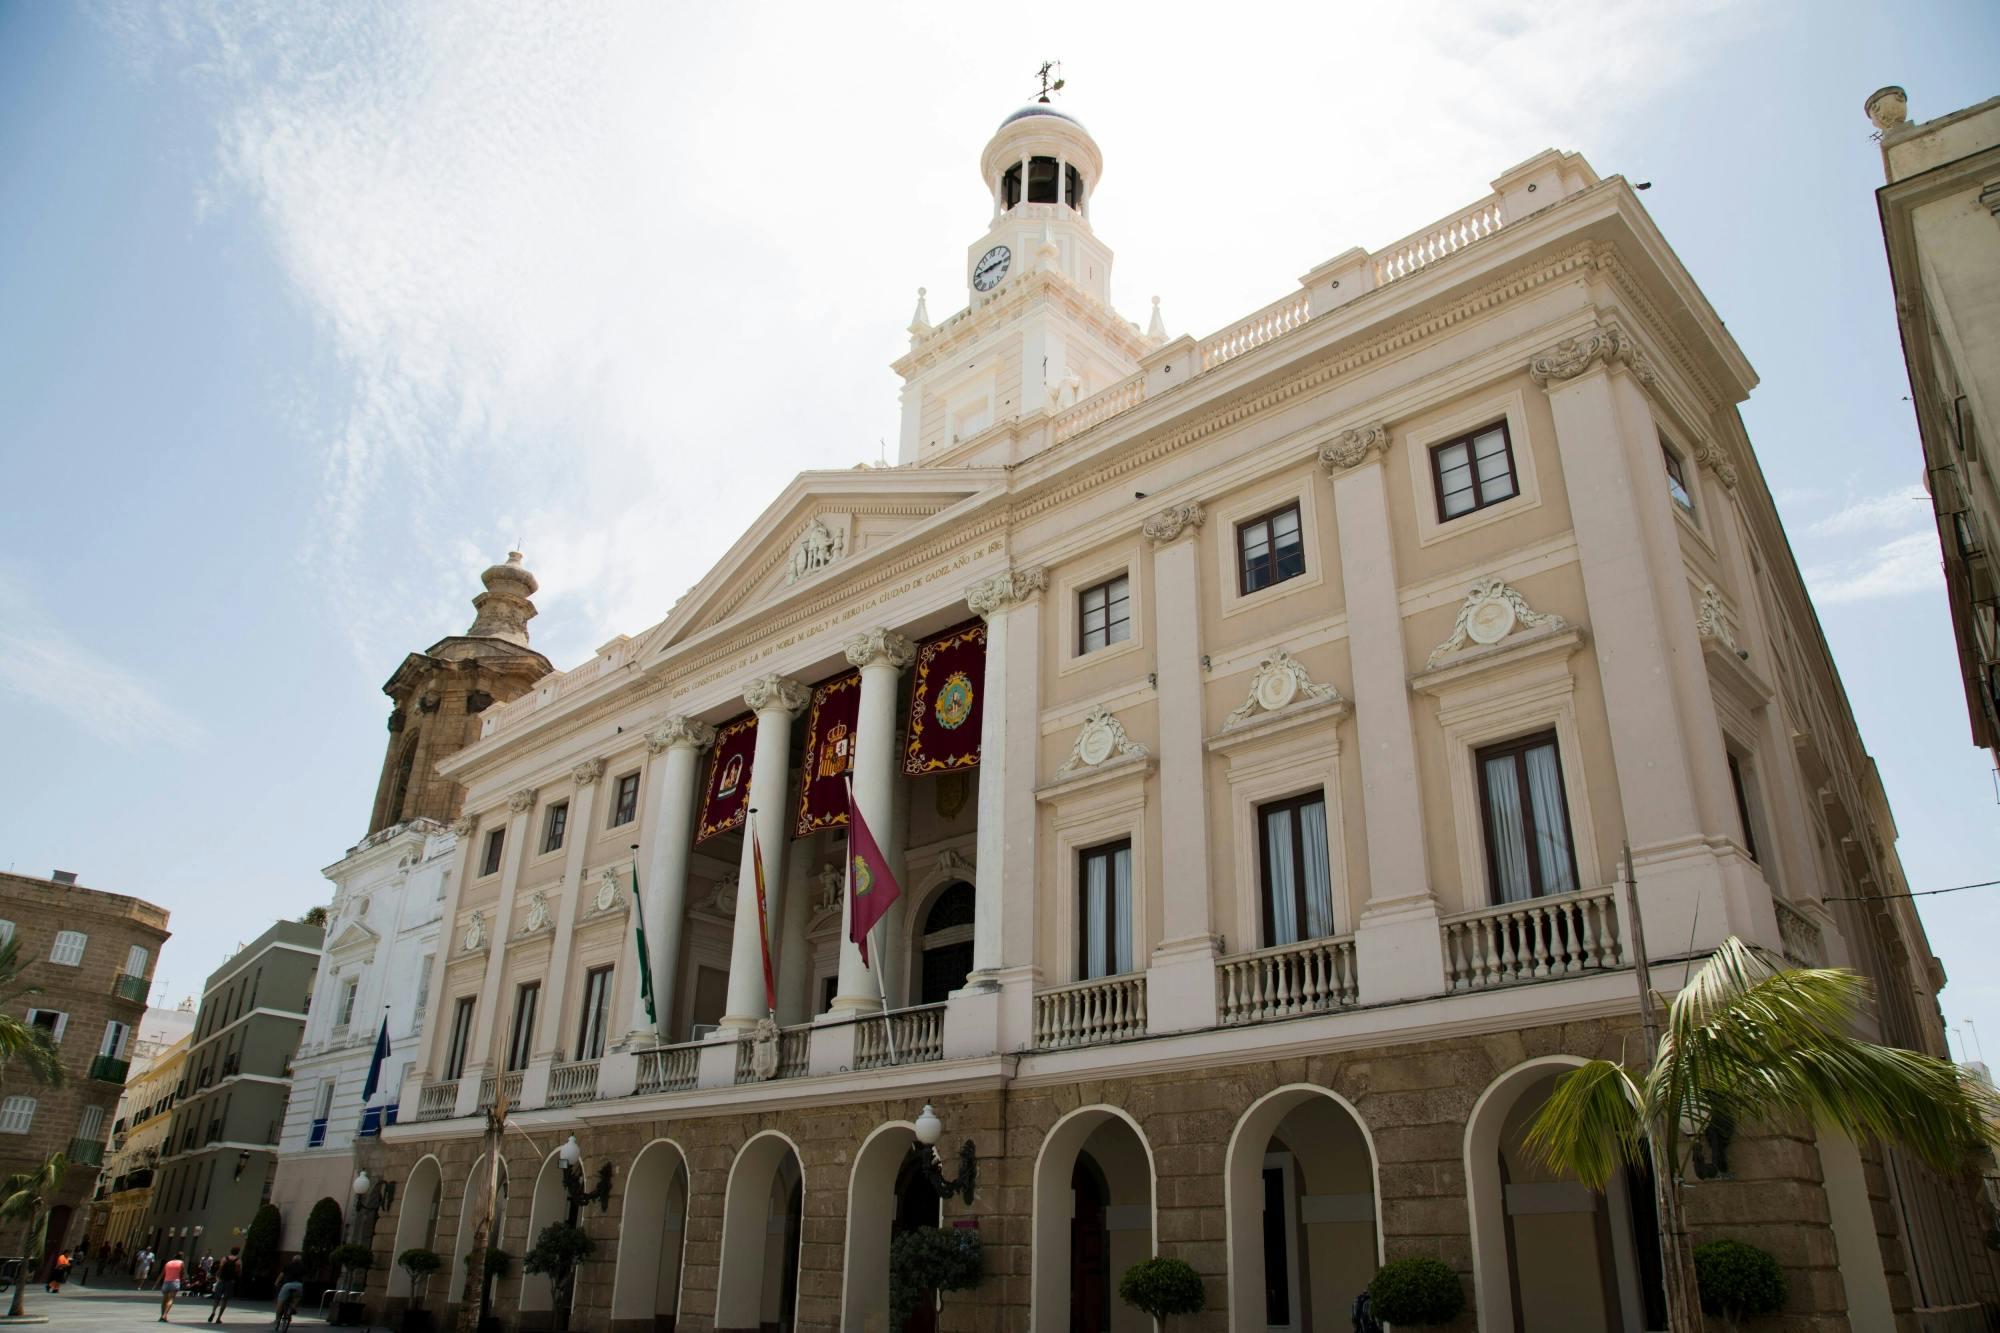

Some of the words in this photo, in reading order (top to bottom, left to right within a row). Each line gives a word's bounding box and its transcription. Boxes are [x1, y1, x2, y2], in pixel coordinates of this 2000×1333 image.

[739, 658, 748, 668] DE
[749, 653, 759, 664] LA
[776, 637, 795, 650] NOBLE
[842, 599, 877, 621] HEROICA
[879, 583, 911, 603] CIUDAD
[912, 578, 923, 588] DE
[952, 554, 970, 569] AÑO
[973, 548, 984, 560] DE
